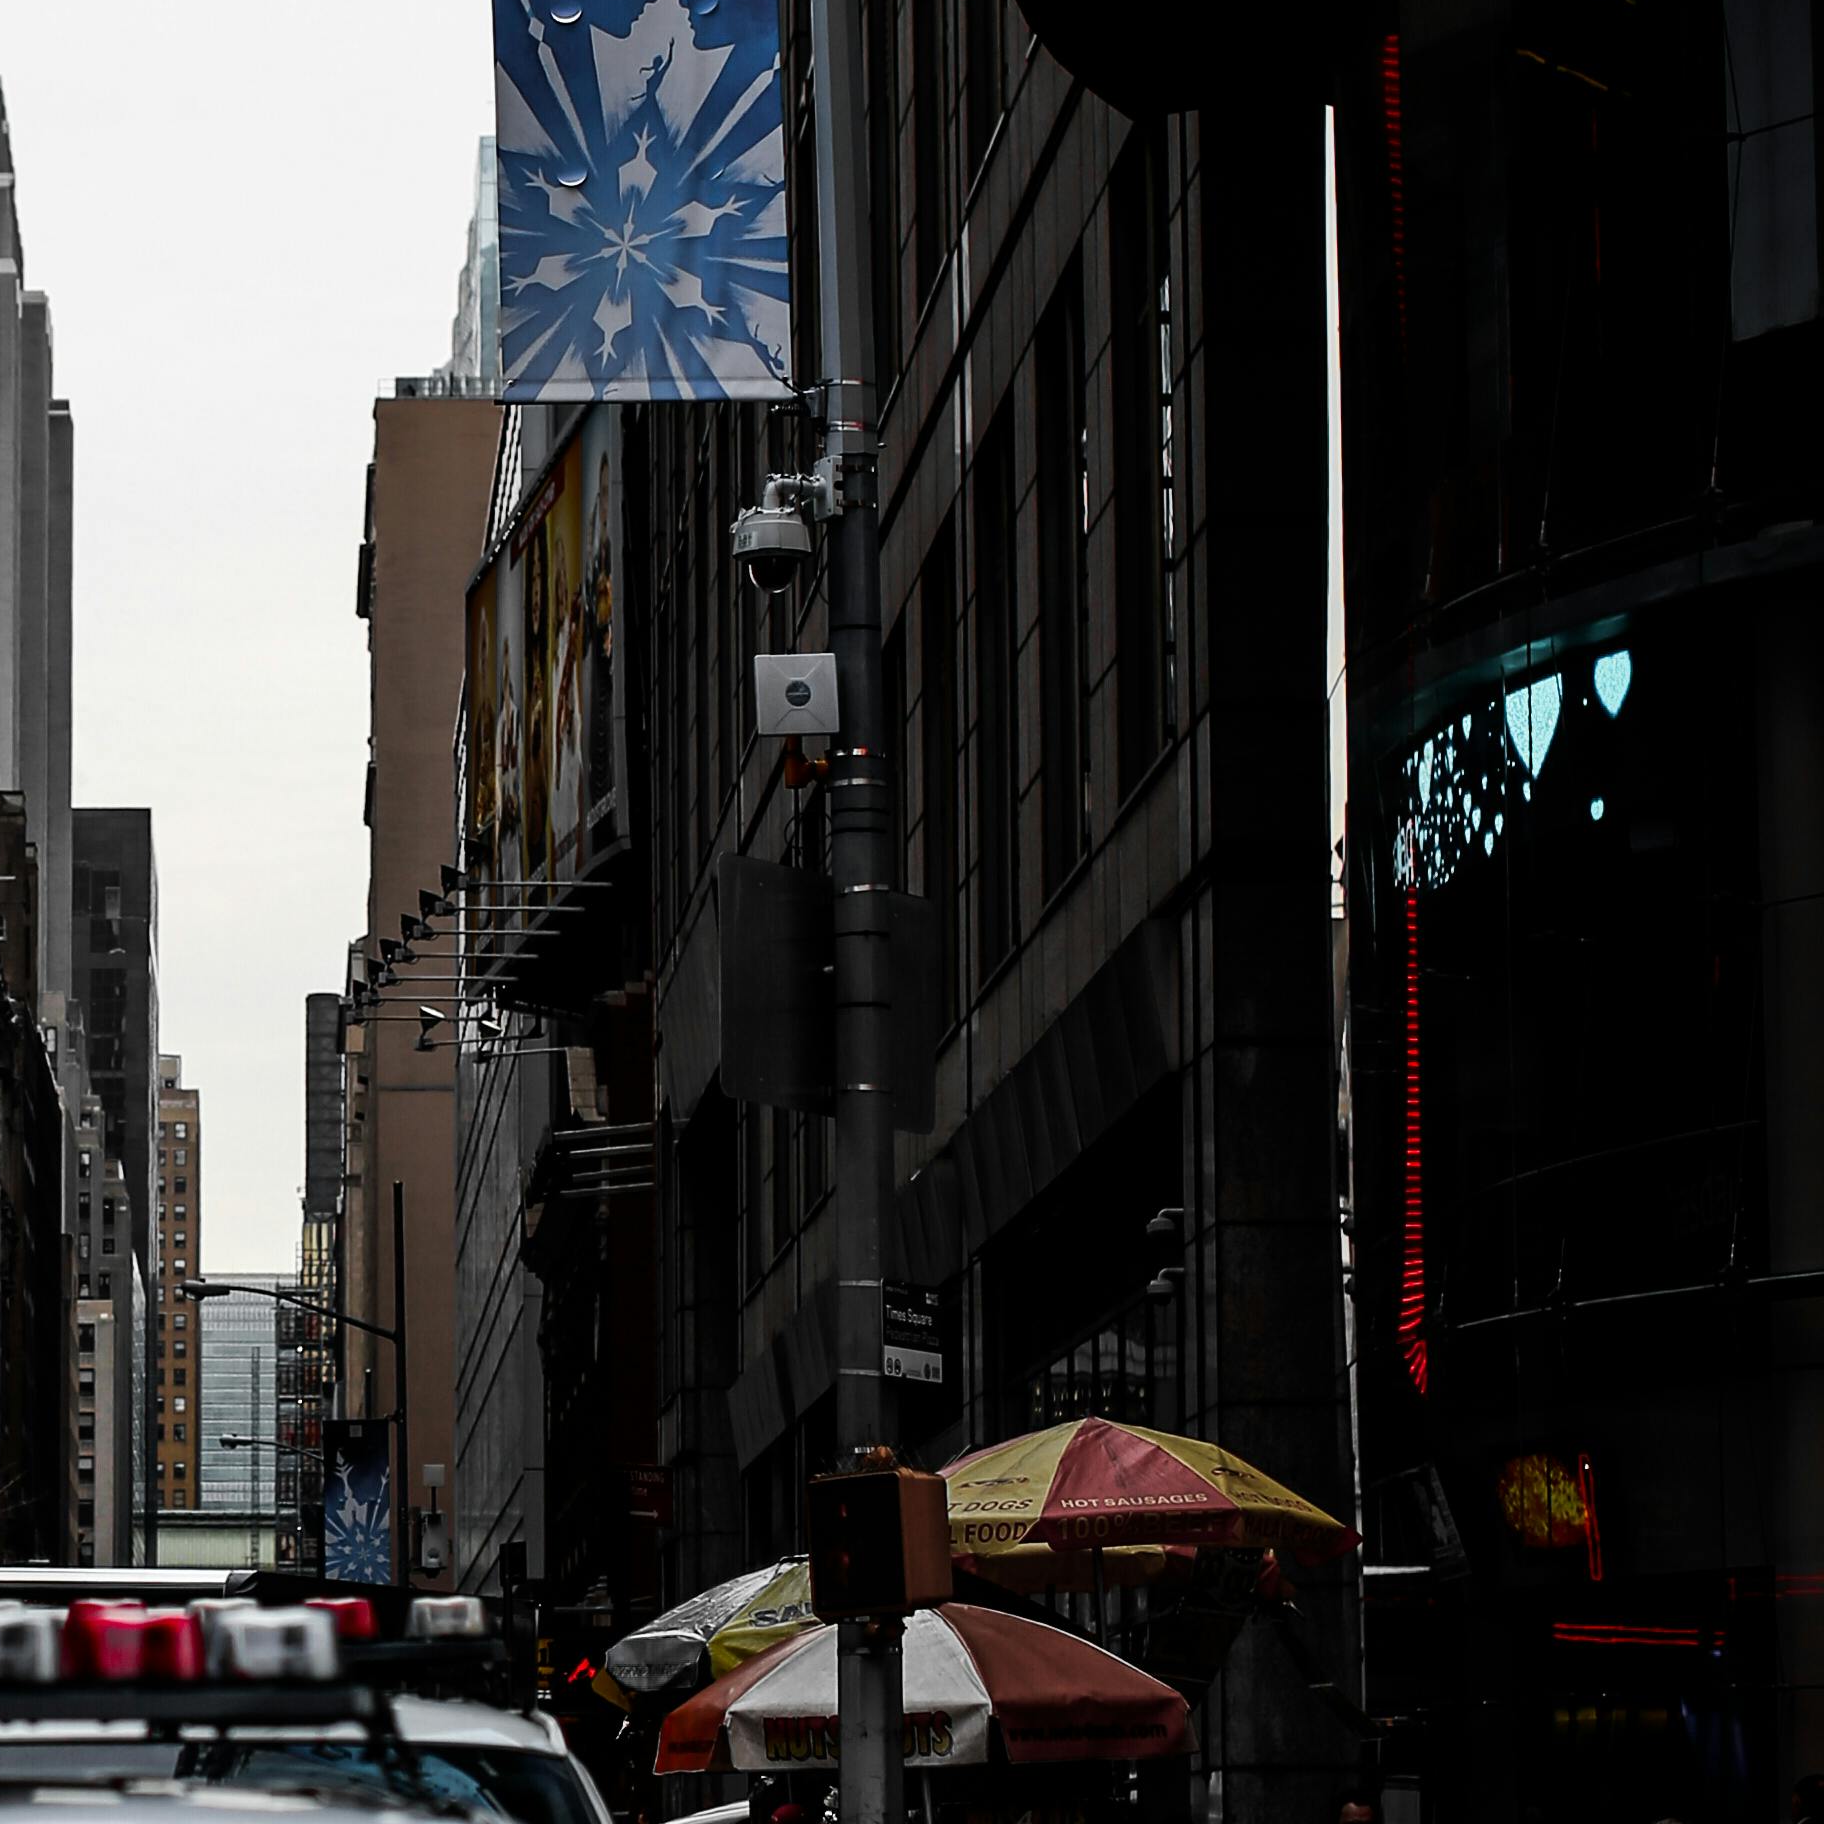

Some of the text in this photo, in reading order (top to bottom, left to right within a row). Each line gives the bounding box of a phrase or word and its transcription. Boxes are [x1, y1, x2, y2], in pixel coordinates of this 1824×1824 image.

[962, 1499, 1034, 1513] DOGS
[1060, 1492, 1209, 1509] HOT SAUSAGES
[964, 1522, 1028, 1544] FOOD
